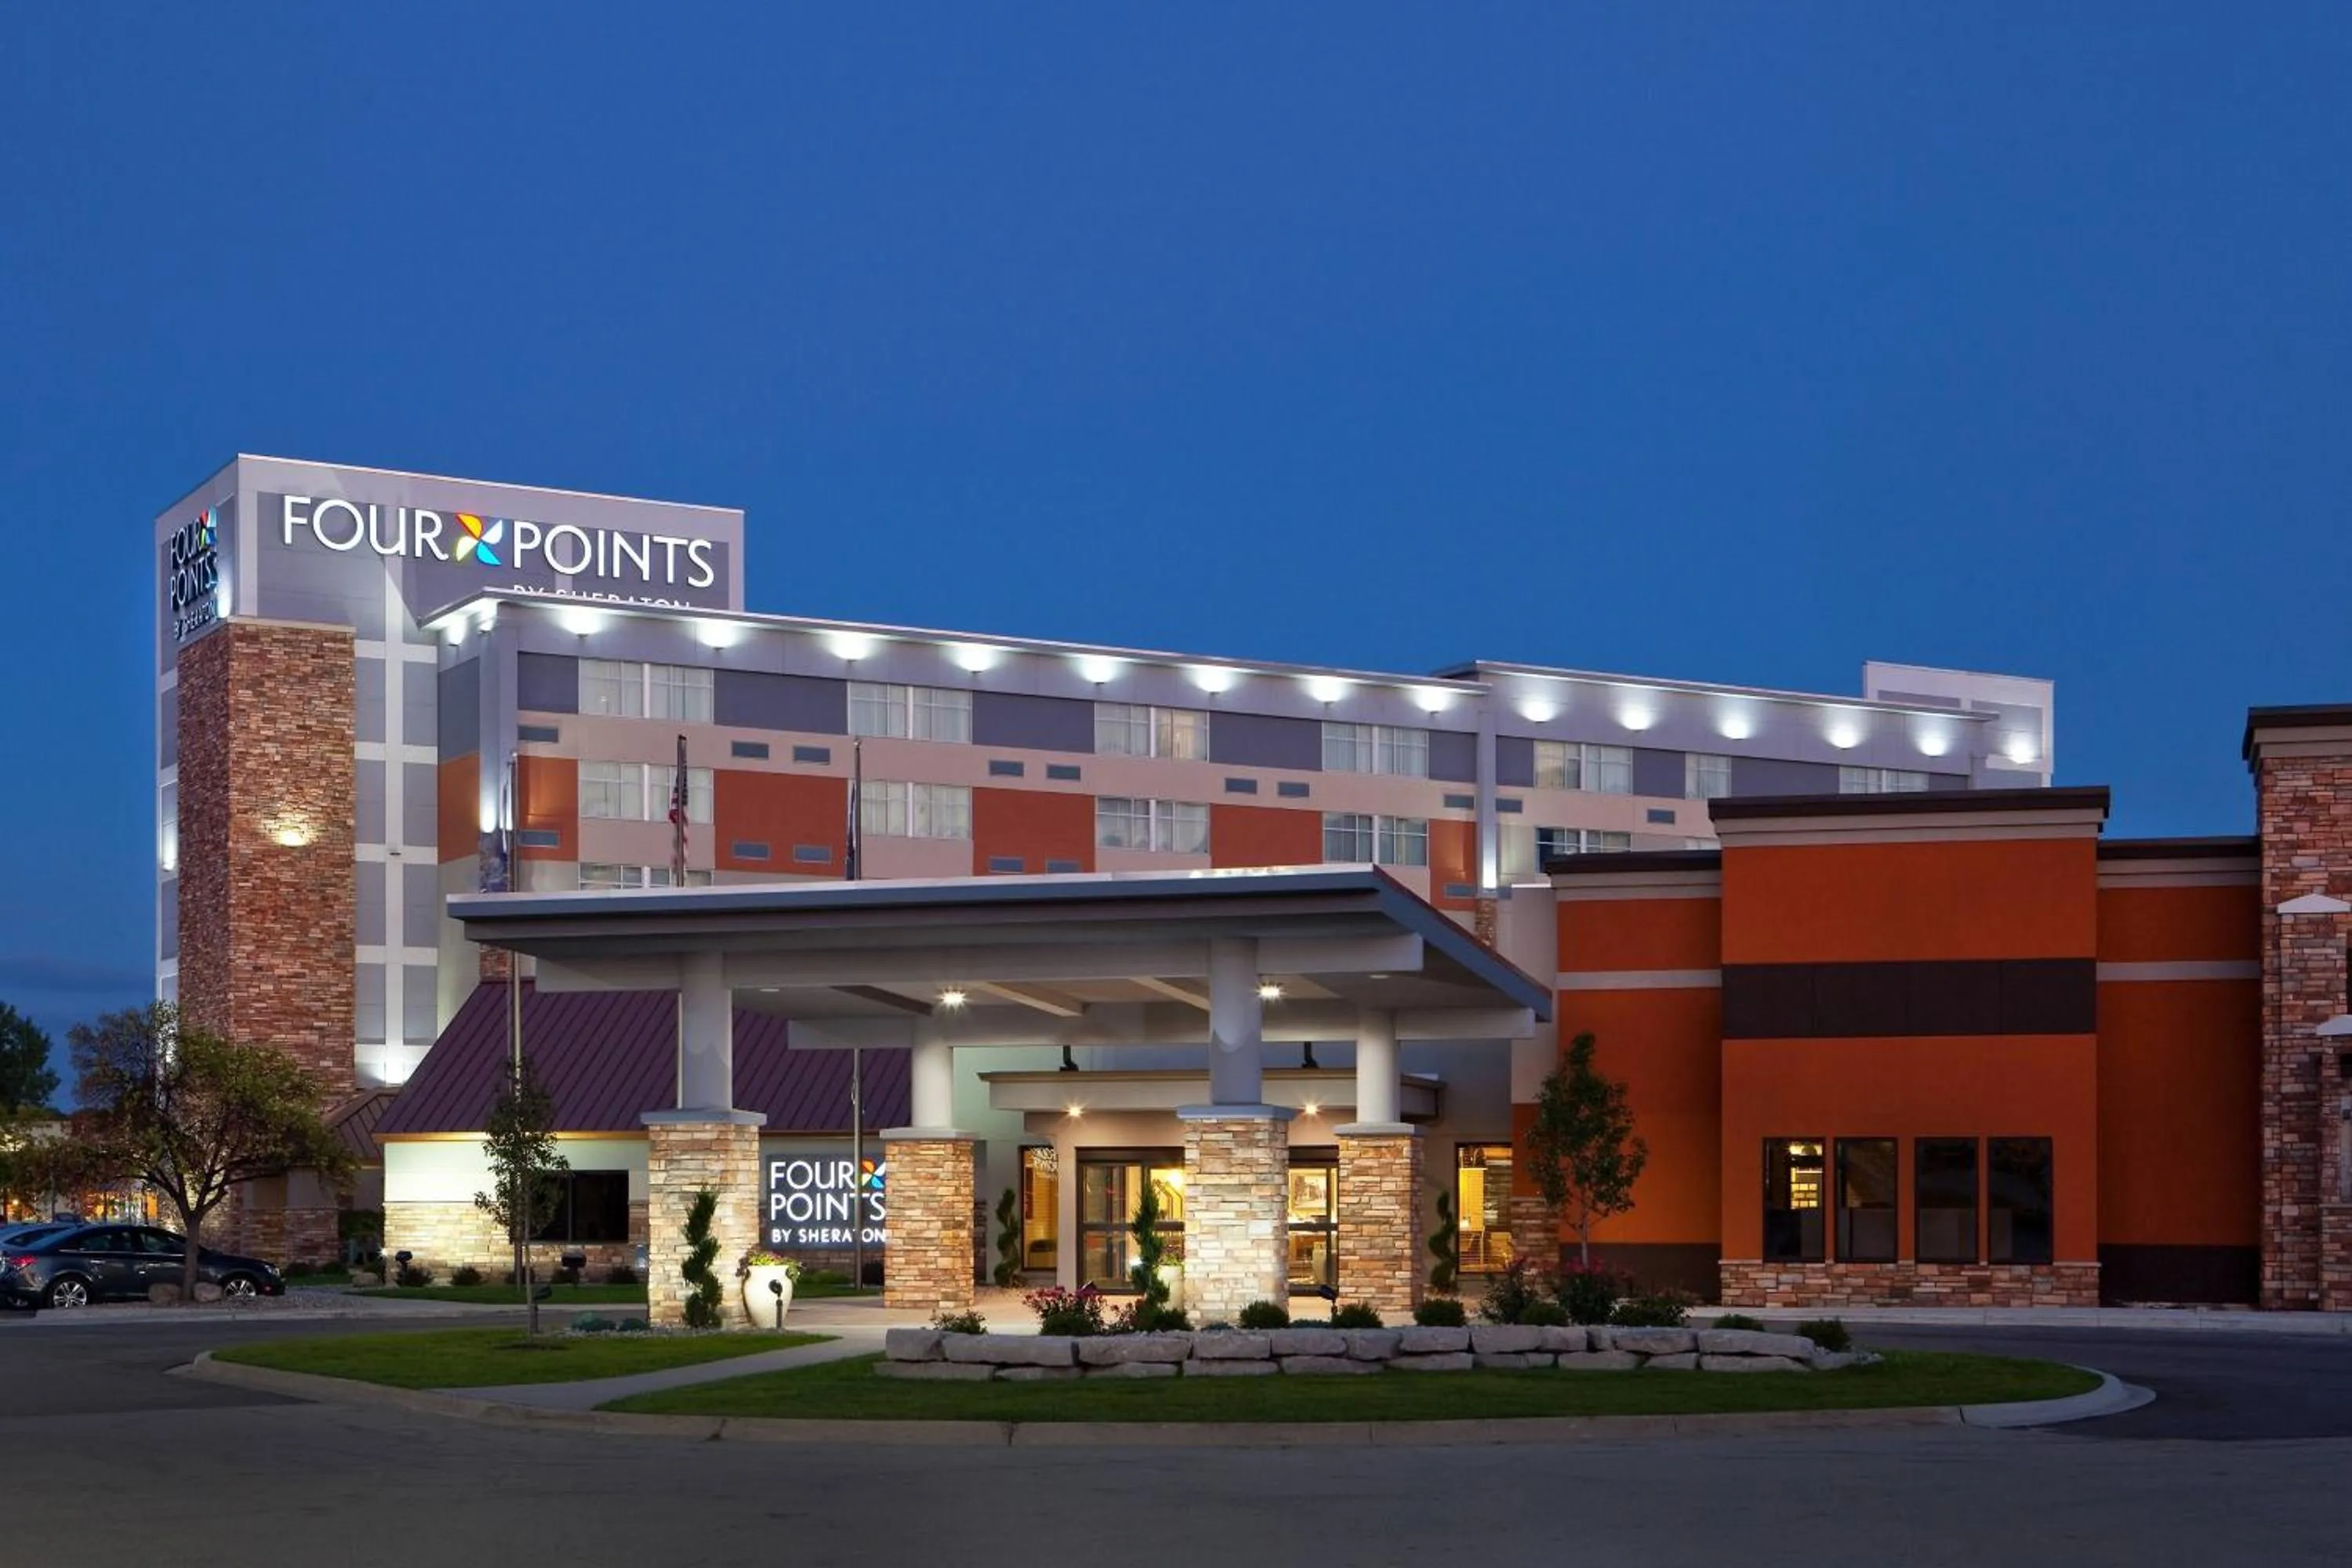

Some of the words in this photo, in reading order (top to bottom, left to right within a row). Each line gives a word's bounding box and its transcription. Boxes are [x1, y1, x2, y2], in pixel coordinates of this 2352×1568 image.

[170, 517, 201, 567] FOUR
[284, 495, 449, 561] FOUR
[513, 521, 715, 587] POINTS
[170, 551, 213, 610] POINTS
[771, 1161, 856, 1189] FOUR
[771, 1228, 792, 1243] BY
[798, 1228, 887, 1243] SHERAON
